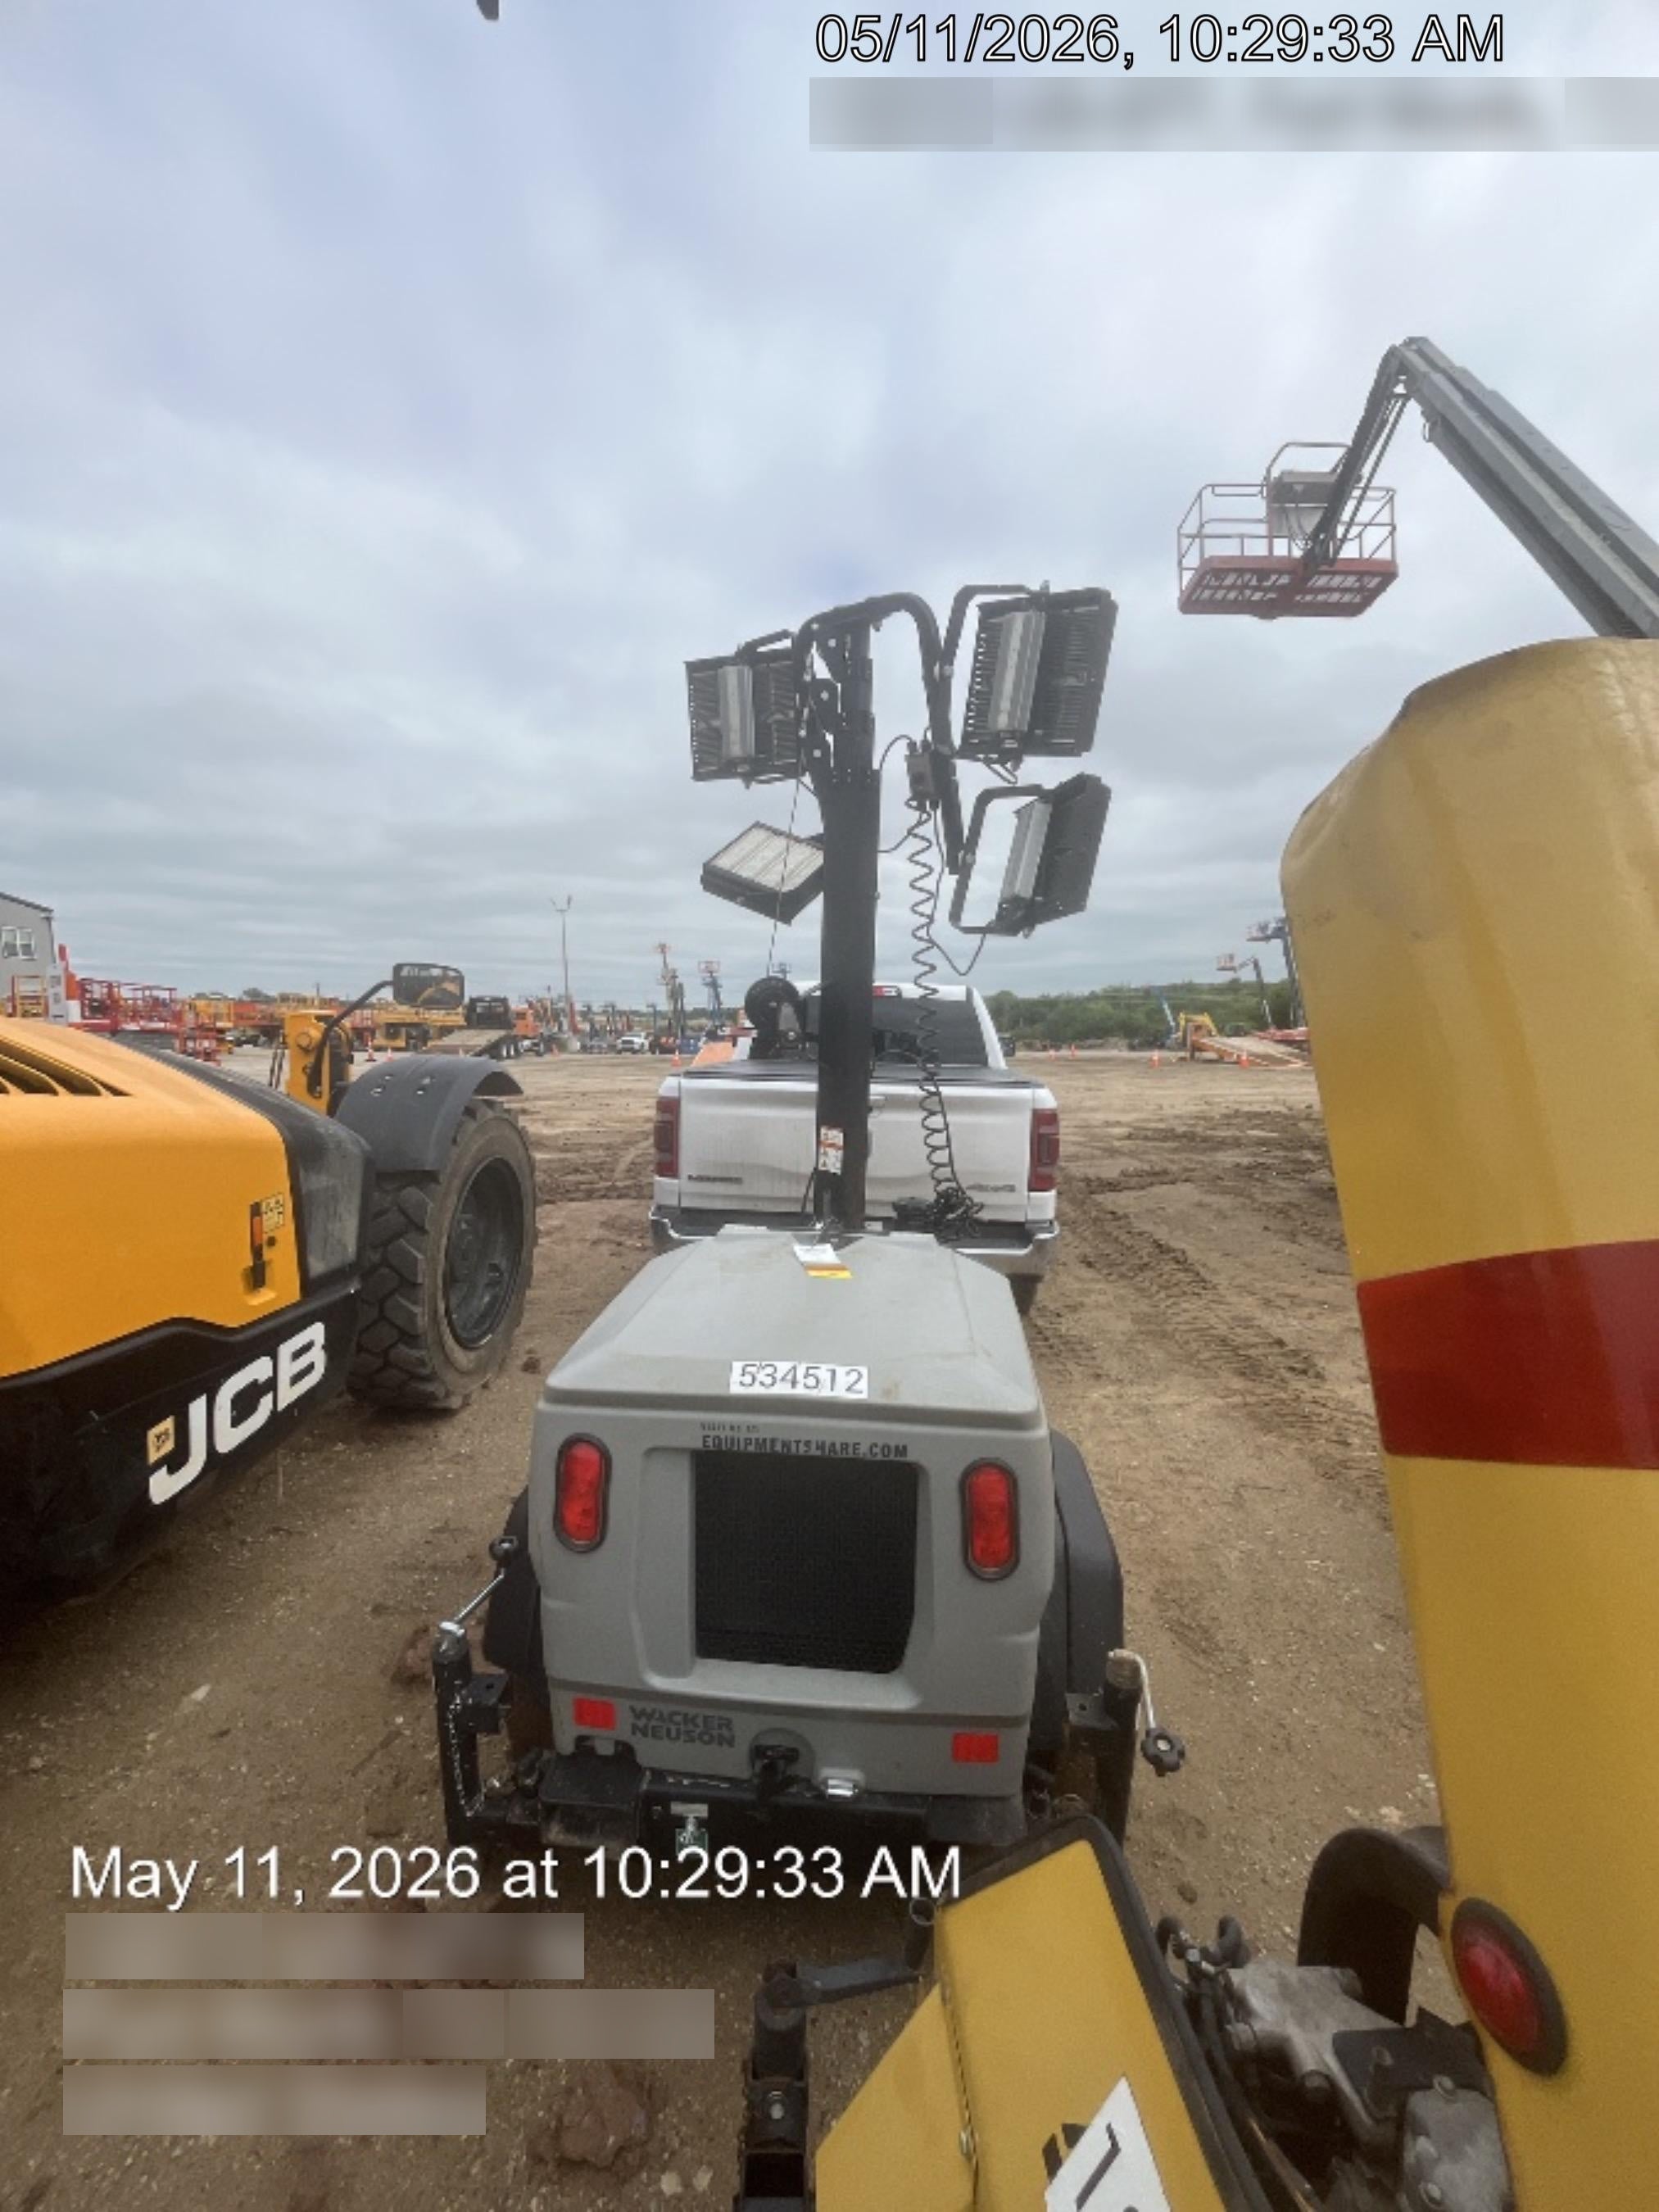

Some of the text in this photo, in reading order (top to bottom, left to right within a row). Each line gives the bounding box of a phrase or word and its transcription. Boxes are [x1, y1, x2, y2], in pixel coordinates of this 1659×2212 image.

[739, 1363, 863, 1394] 534512
[148, 1321, 326, 1504] JCB
[702, 1435, 909, 1458] EQUIPMENTSHARE.COM
[629, 1705, 733, 1731] WACKER
[631, 1723, 736, 1748] NEUSON
